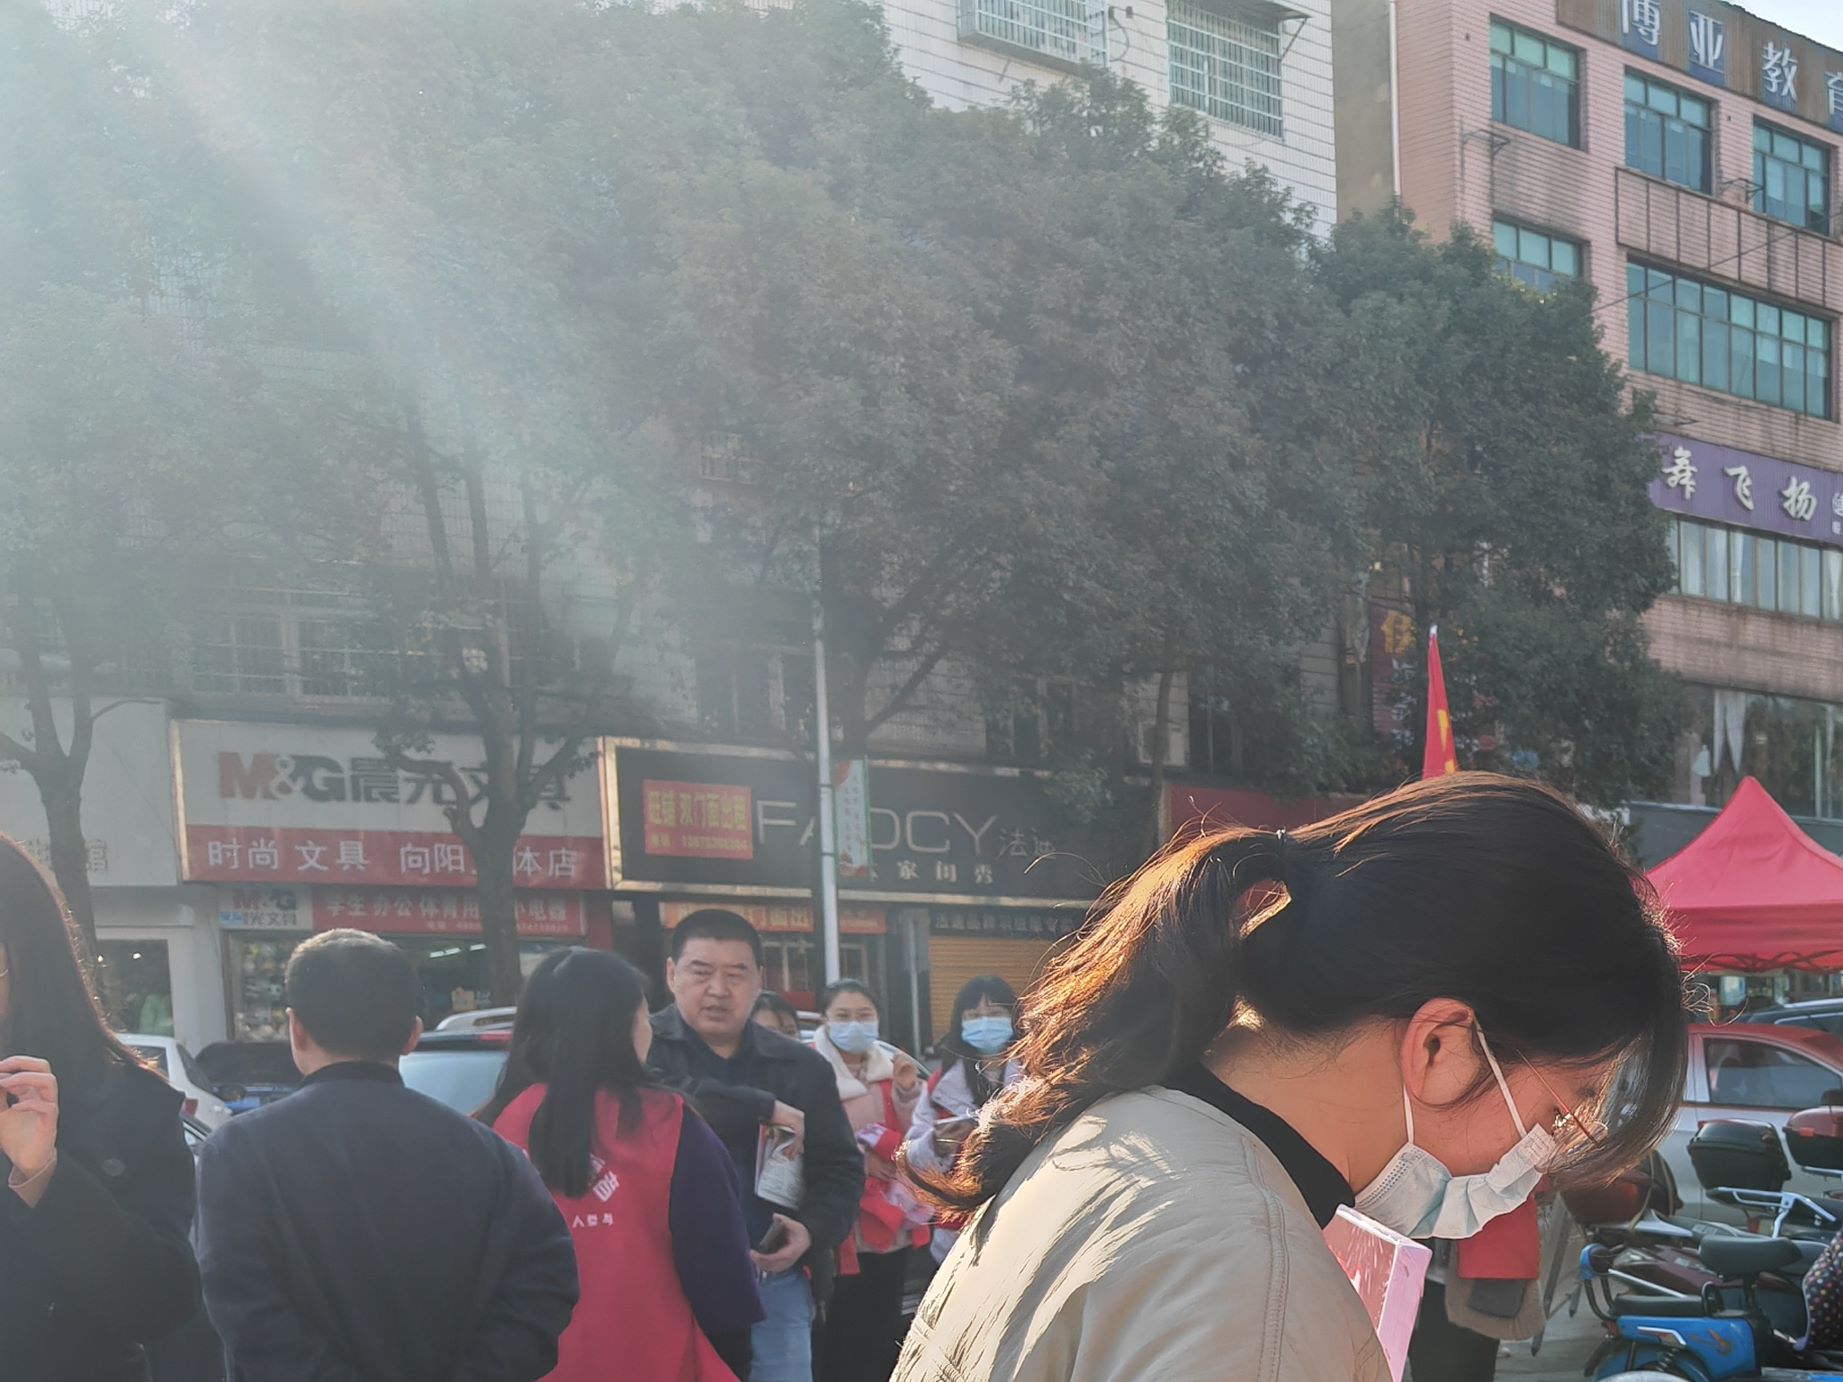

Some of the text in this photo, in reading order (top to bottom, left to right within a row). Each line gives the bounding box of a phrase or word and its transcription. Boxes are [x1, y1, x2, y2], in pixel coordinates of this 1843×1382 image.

[400, 841, 579, 879] 向阳体店
[872, 858, 994, 885] 家闺秀
